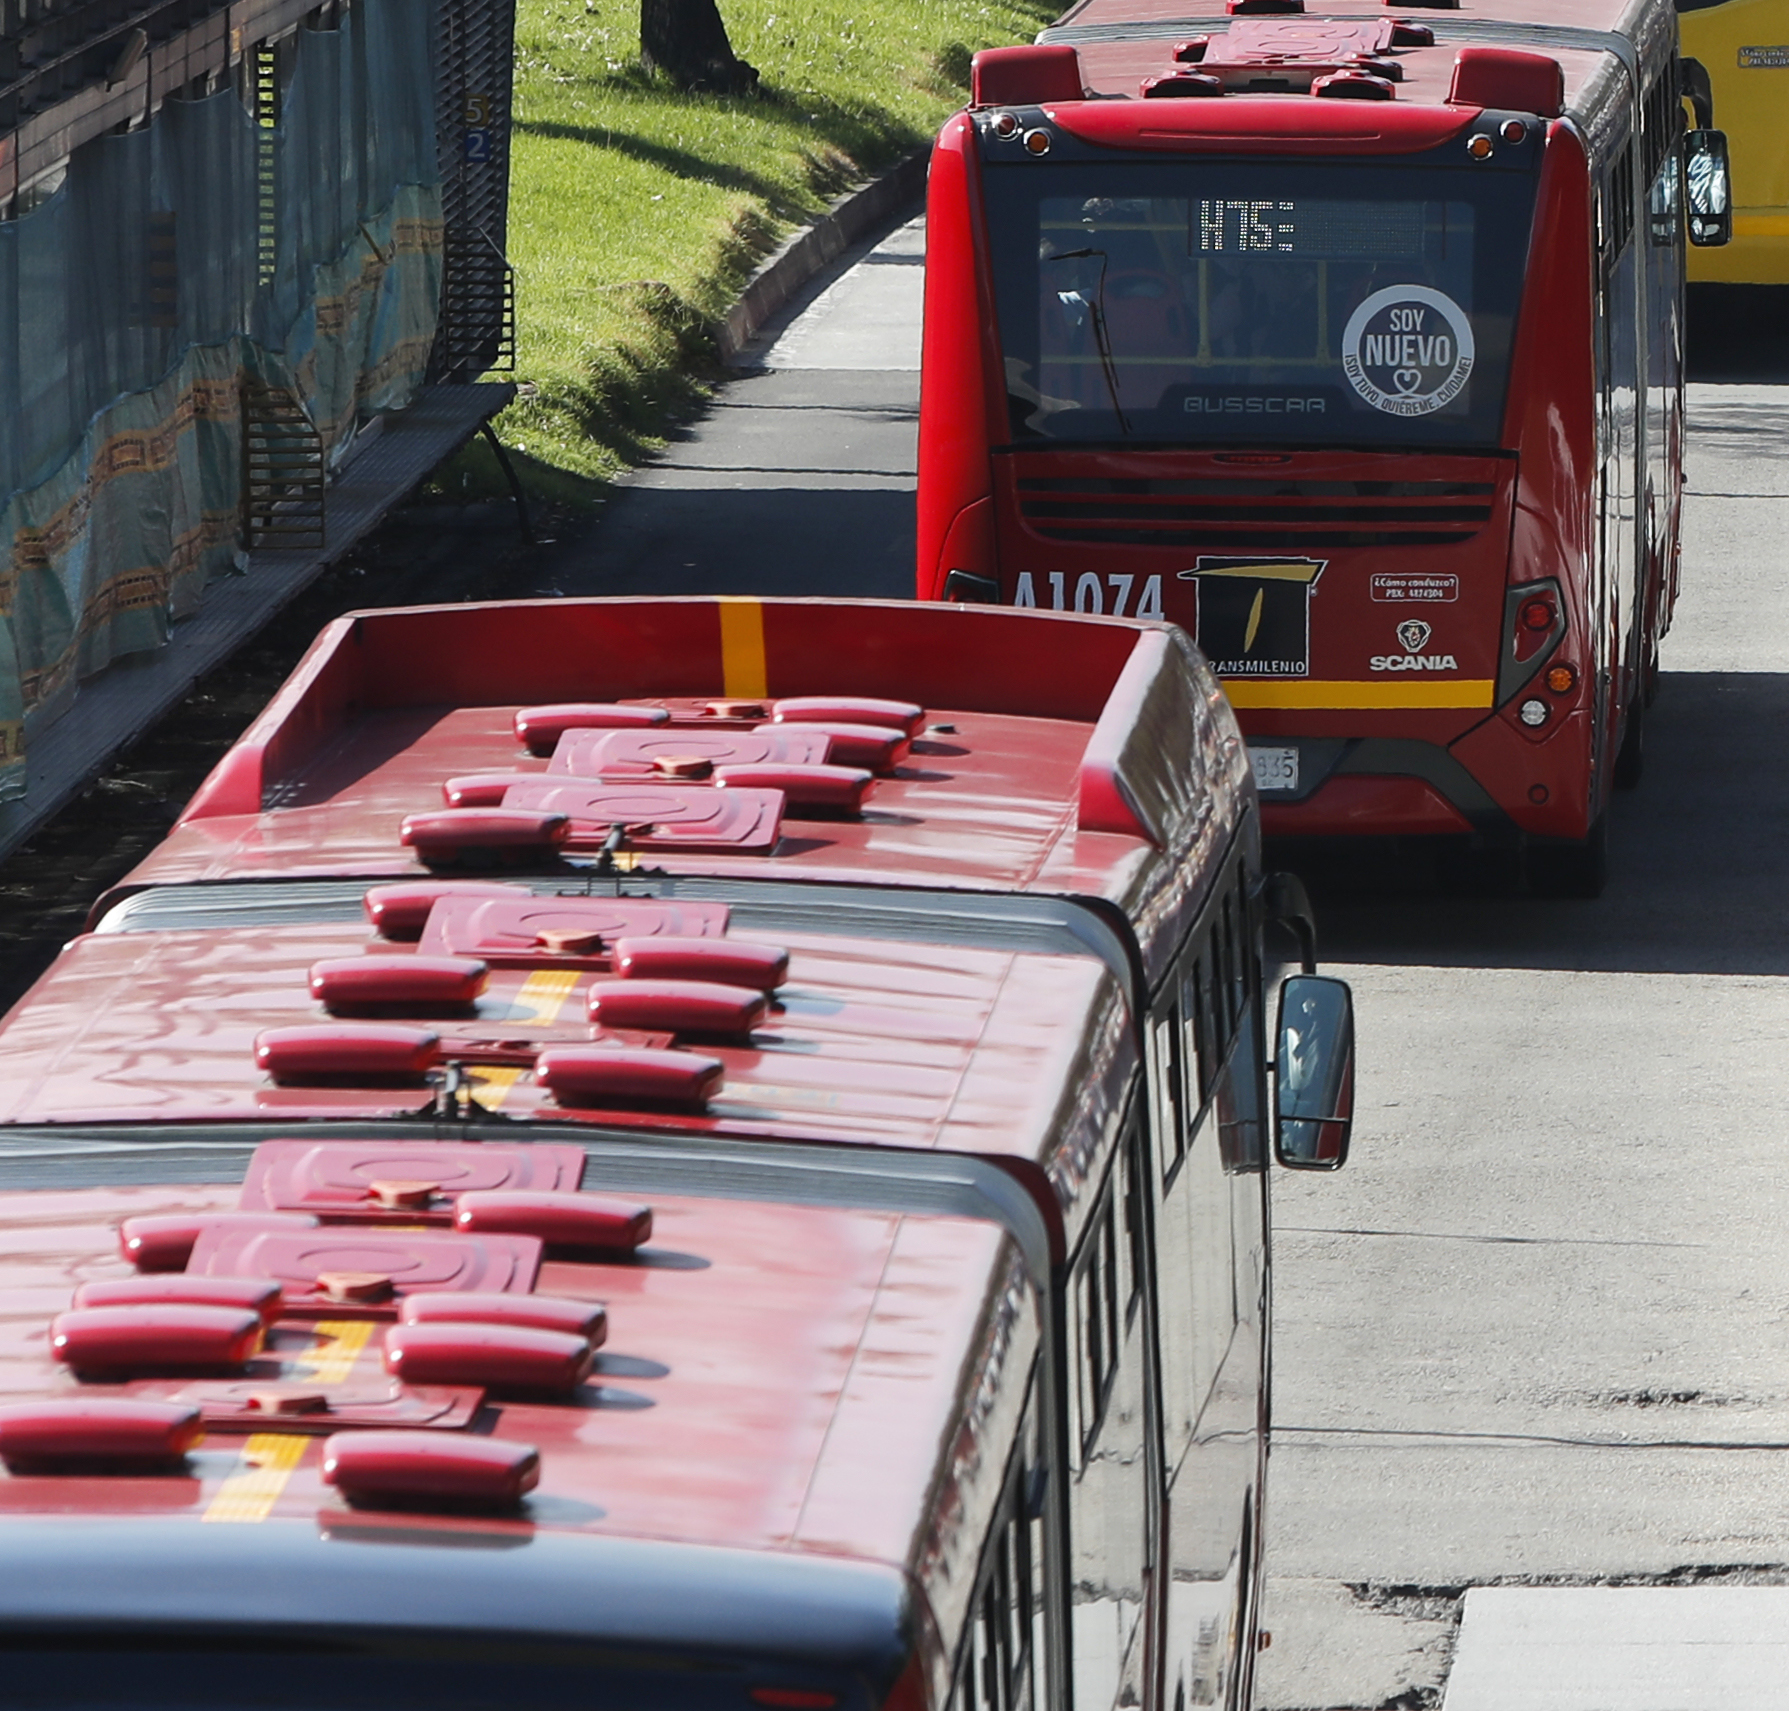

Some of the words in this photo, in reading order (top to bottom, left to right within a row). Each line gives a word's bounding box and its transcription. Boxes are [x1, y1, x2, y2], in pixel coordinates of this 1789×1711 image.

[466, 98, 482, 123] 5
[468, 133, 485, 158] 2
[1390, 309, 1425, 332] SOY
[1366, 335, 1450, 367] NUEVO
[1184, 397, 1325, 413] BUSSCAR
[1014, 571, 1165, 621] A1074
[1207, 659, 1306, 674] RANSMILENIO
[1369, 655, 1458, 671] SCANIA
